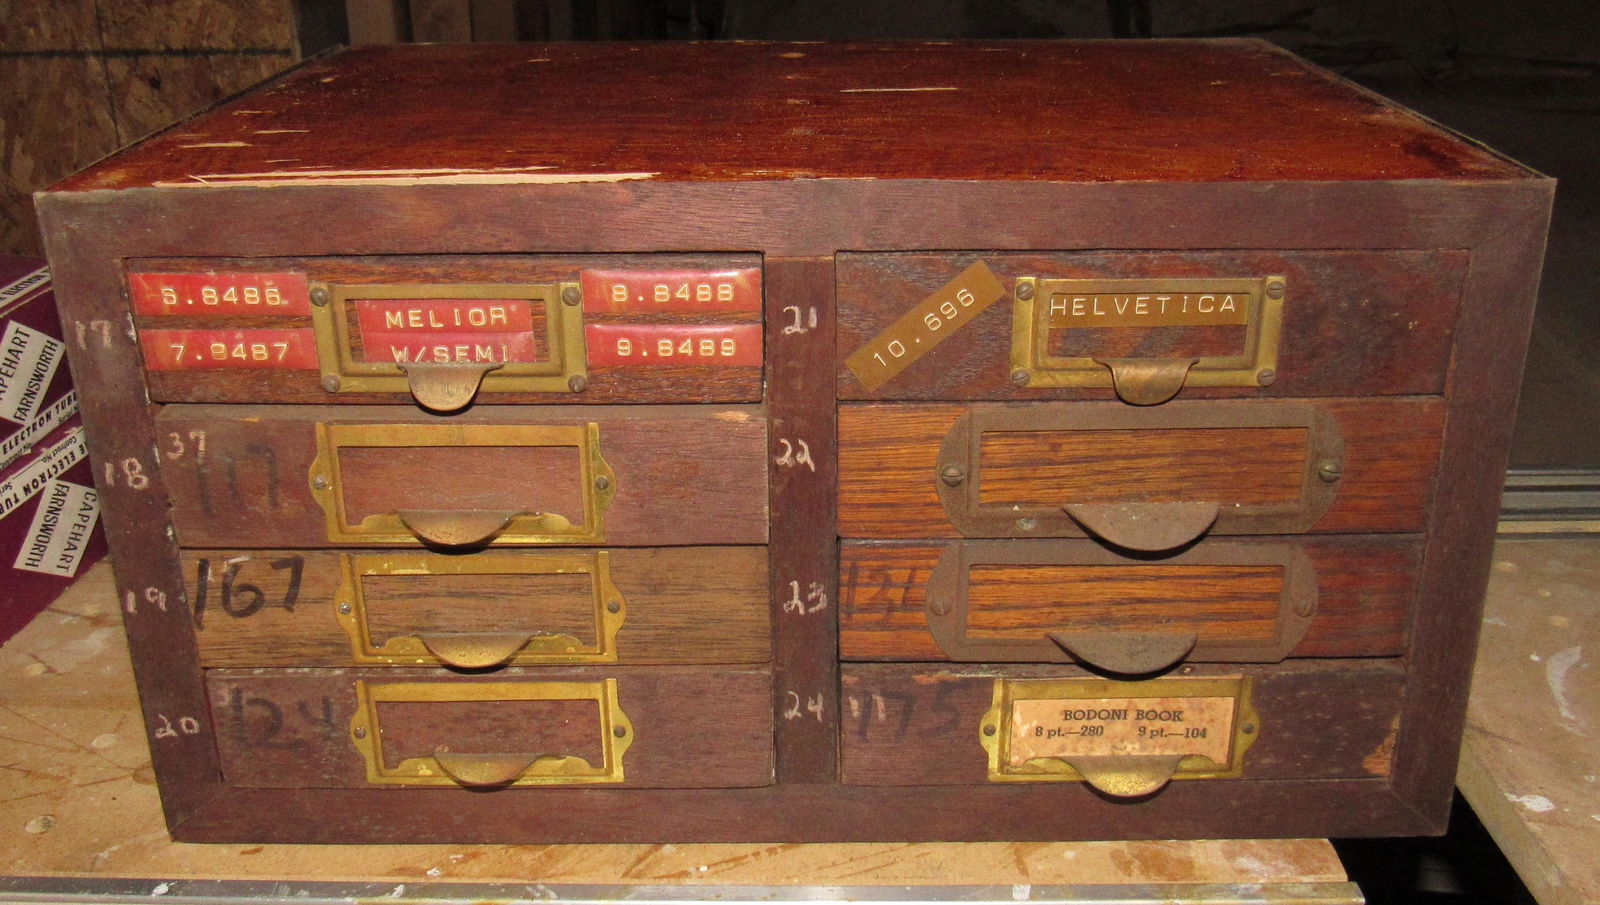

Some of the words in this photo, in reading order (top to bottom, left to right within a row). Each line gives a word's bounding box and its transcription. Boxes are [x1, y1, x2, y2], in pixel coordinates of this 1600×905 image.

[612, 283, 734, 302] 8.8488
[1049, 294, 1236, 317] HELVETICA
[385, 306, 508, 329] MELIOR
[781, 305, 818, 334] 21
[872, 287, 976, 367] 10.696
[75, 319, 112, 349] 17
[616, 338, 736, 357] 9.8489
[170, 343, 290, 361] 7.8487
[390, 343, 509, 363] W/SEMI
[13, 340, 58, 421] FARNSWORTH
[2, 409, 52, 455] ELECTRON
[166, 430, 207, 460] 37
[775, 438, 816, 472] 22
[23, 451, 76, 496] ELECTRON
[105, 456, 149, 490] 18
[25, 483, 70, 568] FARNSWORTH
[56, 491, 98, 572] CAPEHART
[126, 586, 168, 614] 19
[194, 555, 304, 631] 167
[783, 691, 825, 722] 24
[1063, 709, 1128, 721] BODONI
[1135, 709, 1184, 722] BOOK
[155, 713, 200, 739] 20
[1034, 726, 1044, 737] 8
[1138, 727, 1147, 737] 9
